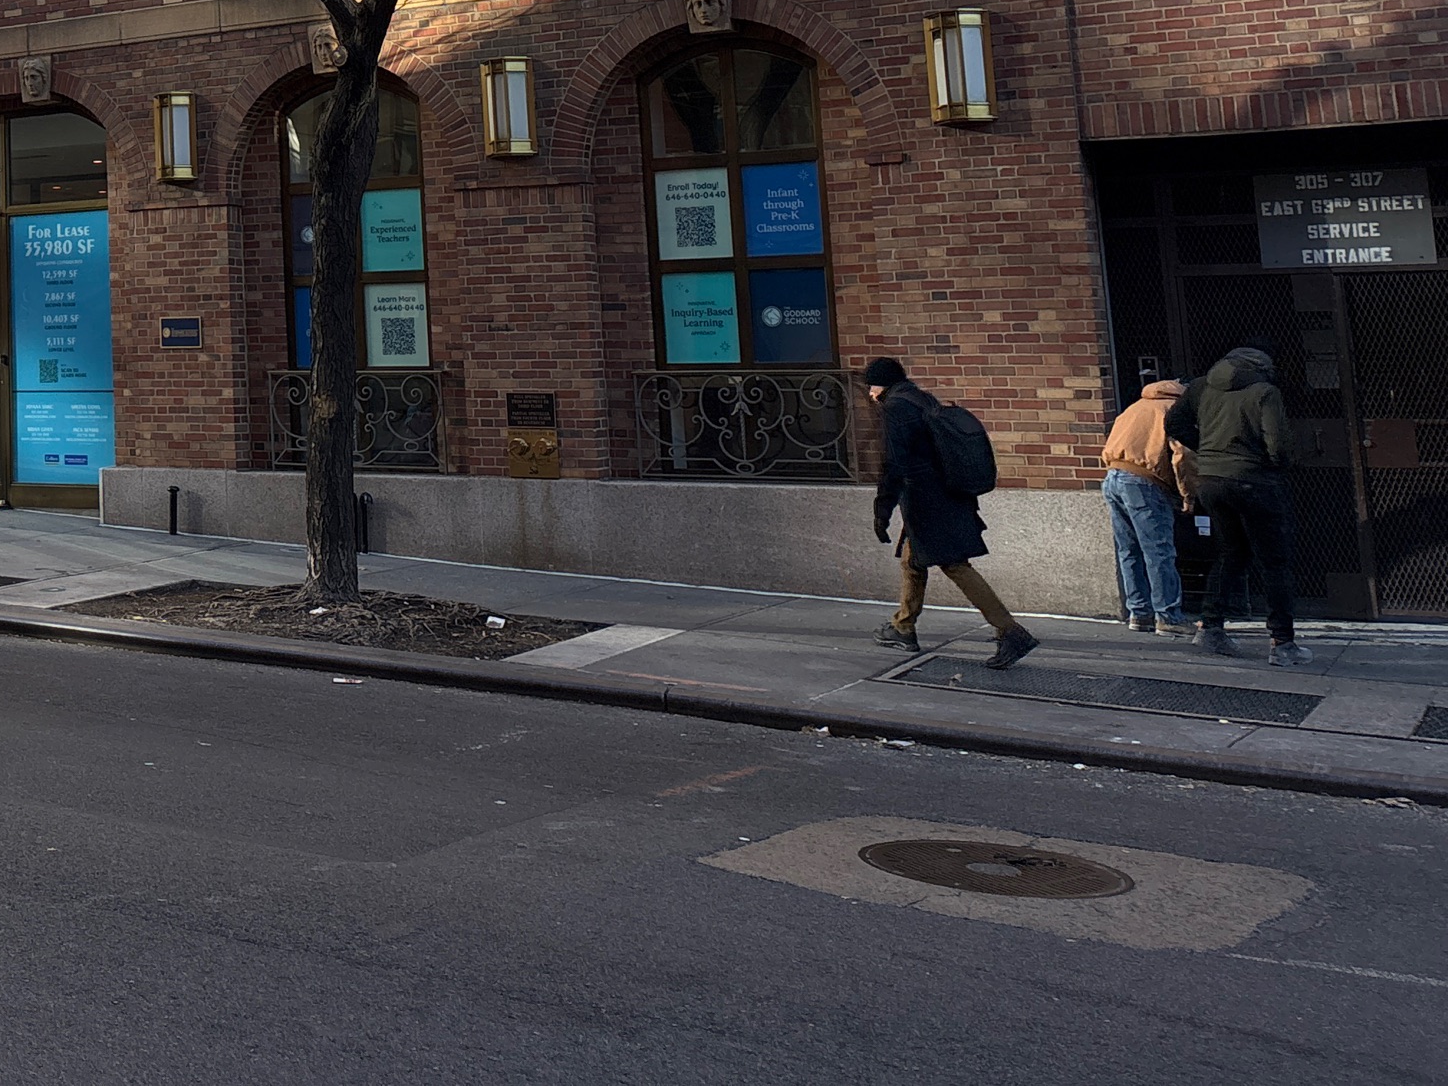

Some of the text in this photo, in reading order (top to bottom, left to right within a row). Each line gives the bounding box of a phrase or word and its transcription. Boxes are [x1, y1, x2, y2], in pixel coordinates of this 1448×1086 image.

[667, 181, 719, 192] Enroll Today!
[1294, 173, 1328, 191] 305
[1350, 171, 1384, 188] 307
[665, 190, 726, 201] 646-640-0440
[767, 188, 799, 198] Infant
[762, 199, 805, 210] through
[1260, 200, 1304, 217] EAST
[1358, 194, 1425, 213] STREET
[771, 210, 800, 221] Pre-K
[370, 224, 417, 235] Experienced
[756, 223, 815, 233] Classrooms
[1307, 222, 1381, 240] SERVICE
[376, 234, 410, 243] Teachers
[24, 239, 95, 259] 35,980 SF
[1301, 247, 1393, 265] ENTRANCE
[42, 270, 78, 280] 12,599 SF
[66, 292, 76, 300] SF
[373, 304, 425, 312] 646-640-0440
[671, 306, 734, 319] Inquiry-Based
[783, 309, 821, 318] GODDARD
[43, 314, 79, 324] 10,403 SF
[683, 318, 725, 329] Learning
[46, 337, 76, 347] 5,111 SF
